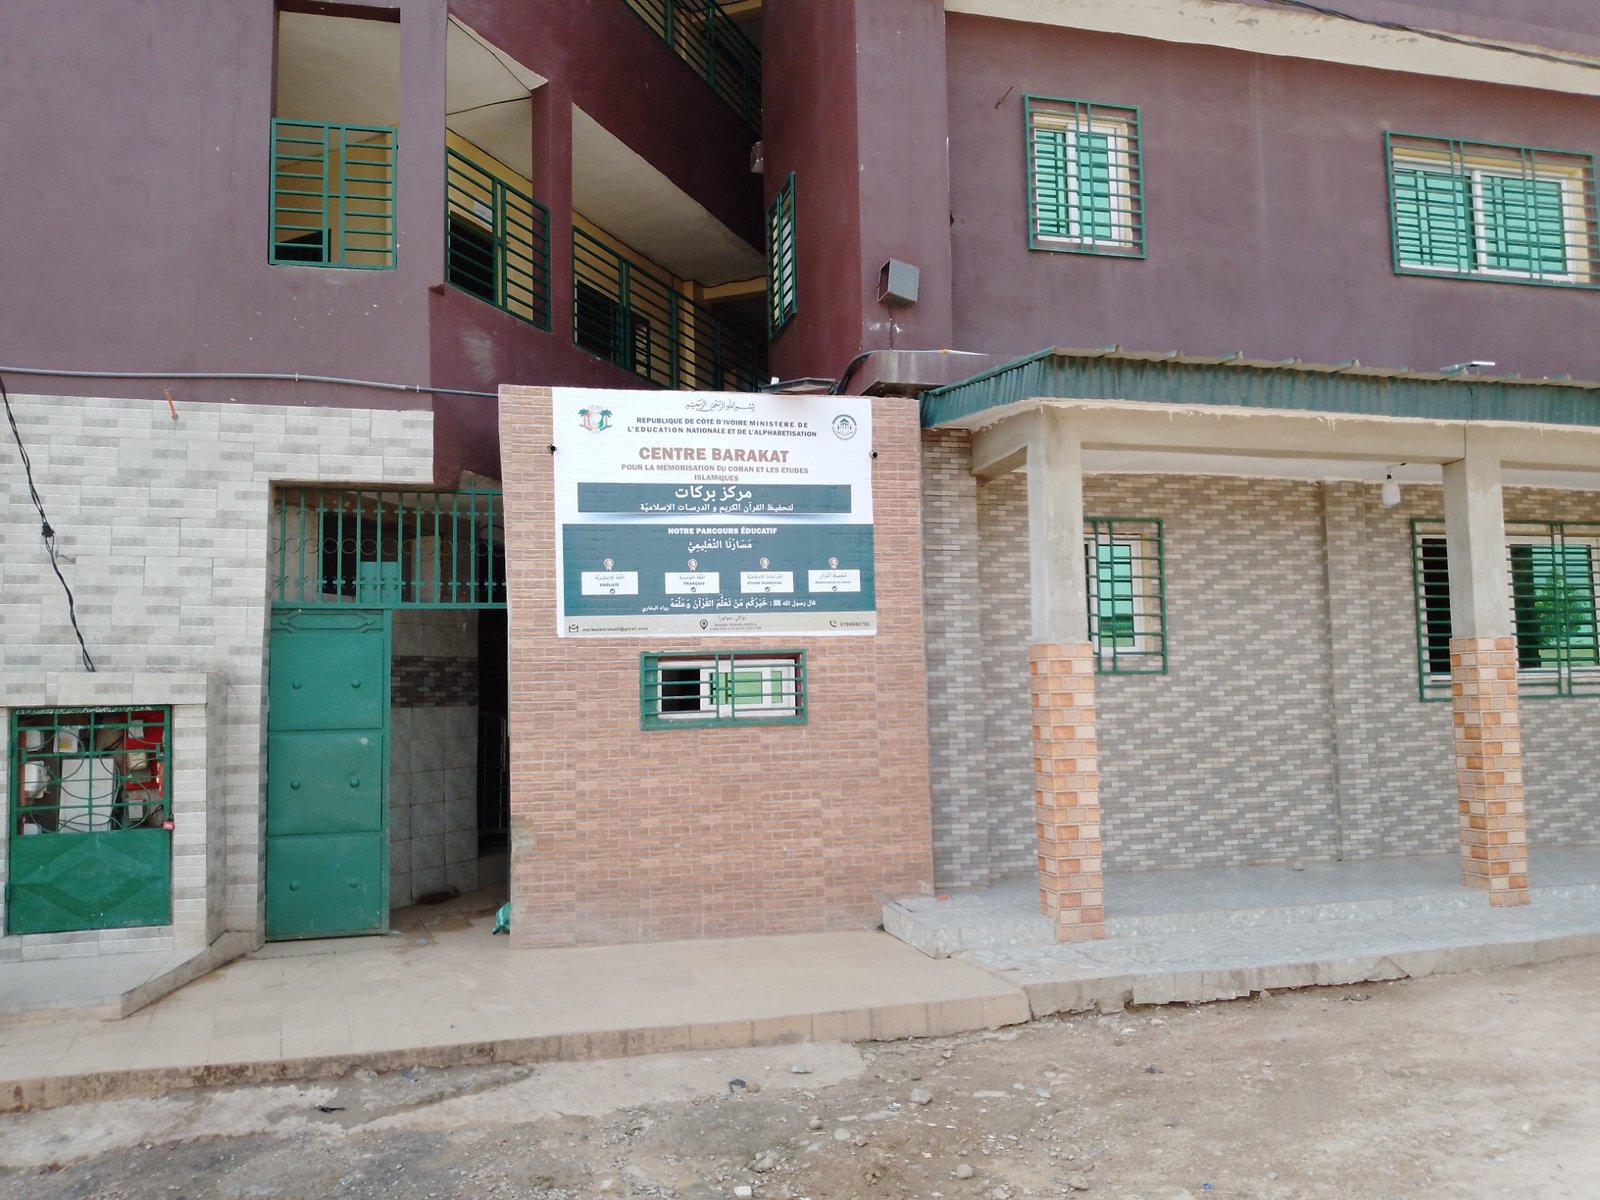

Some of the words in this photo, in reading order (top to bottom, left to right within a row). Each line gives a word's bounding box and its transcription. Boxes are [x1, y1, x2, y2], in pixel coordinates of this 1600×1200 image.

[636, 417, 683, 425] REPUBLIQUE
[696, 417, 715, 426] CÔTE
[716, 418, 748, 426] D'IVOIRE
[750, 420, 794, 428] MINISTERE
[748, 428, 817, 438] L'ALPHABETISATION
[639, 446, 706, 461] CENTRE
[712, 448, 789, 463] BARAKAT
[656, 463, 715, 472] MÉMORISATION
[781, 465, 808, 474] ÉTUDES
[694, 474, 739, 482] ISLAMIQUES
[675, 484, 716, 502] بركات
[719, 485, 752, 502] مركز
[720, 503, 740, 513] الكريم
[743, 502, 764, 513] القرآن
[766, 503, 794, 512] لتحفيظ
[741, 526, 778, 535] ÉDUCATIF
